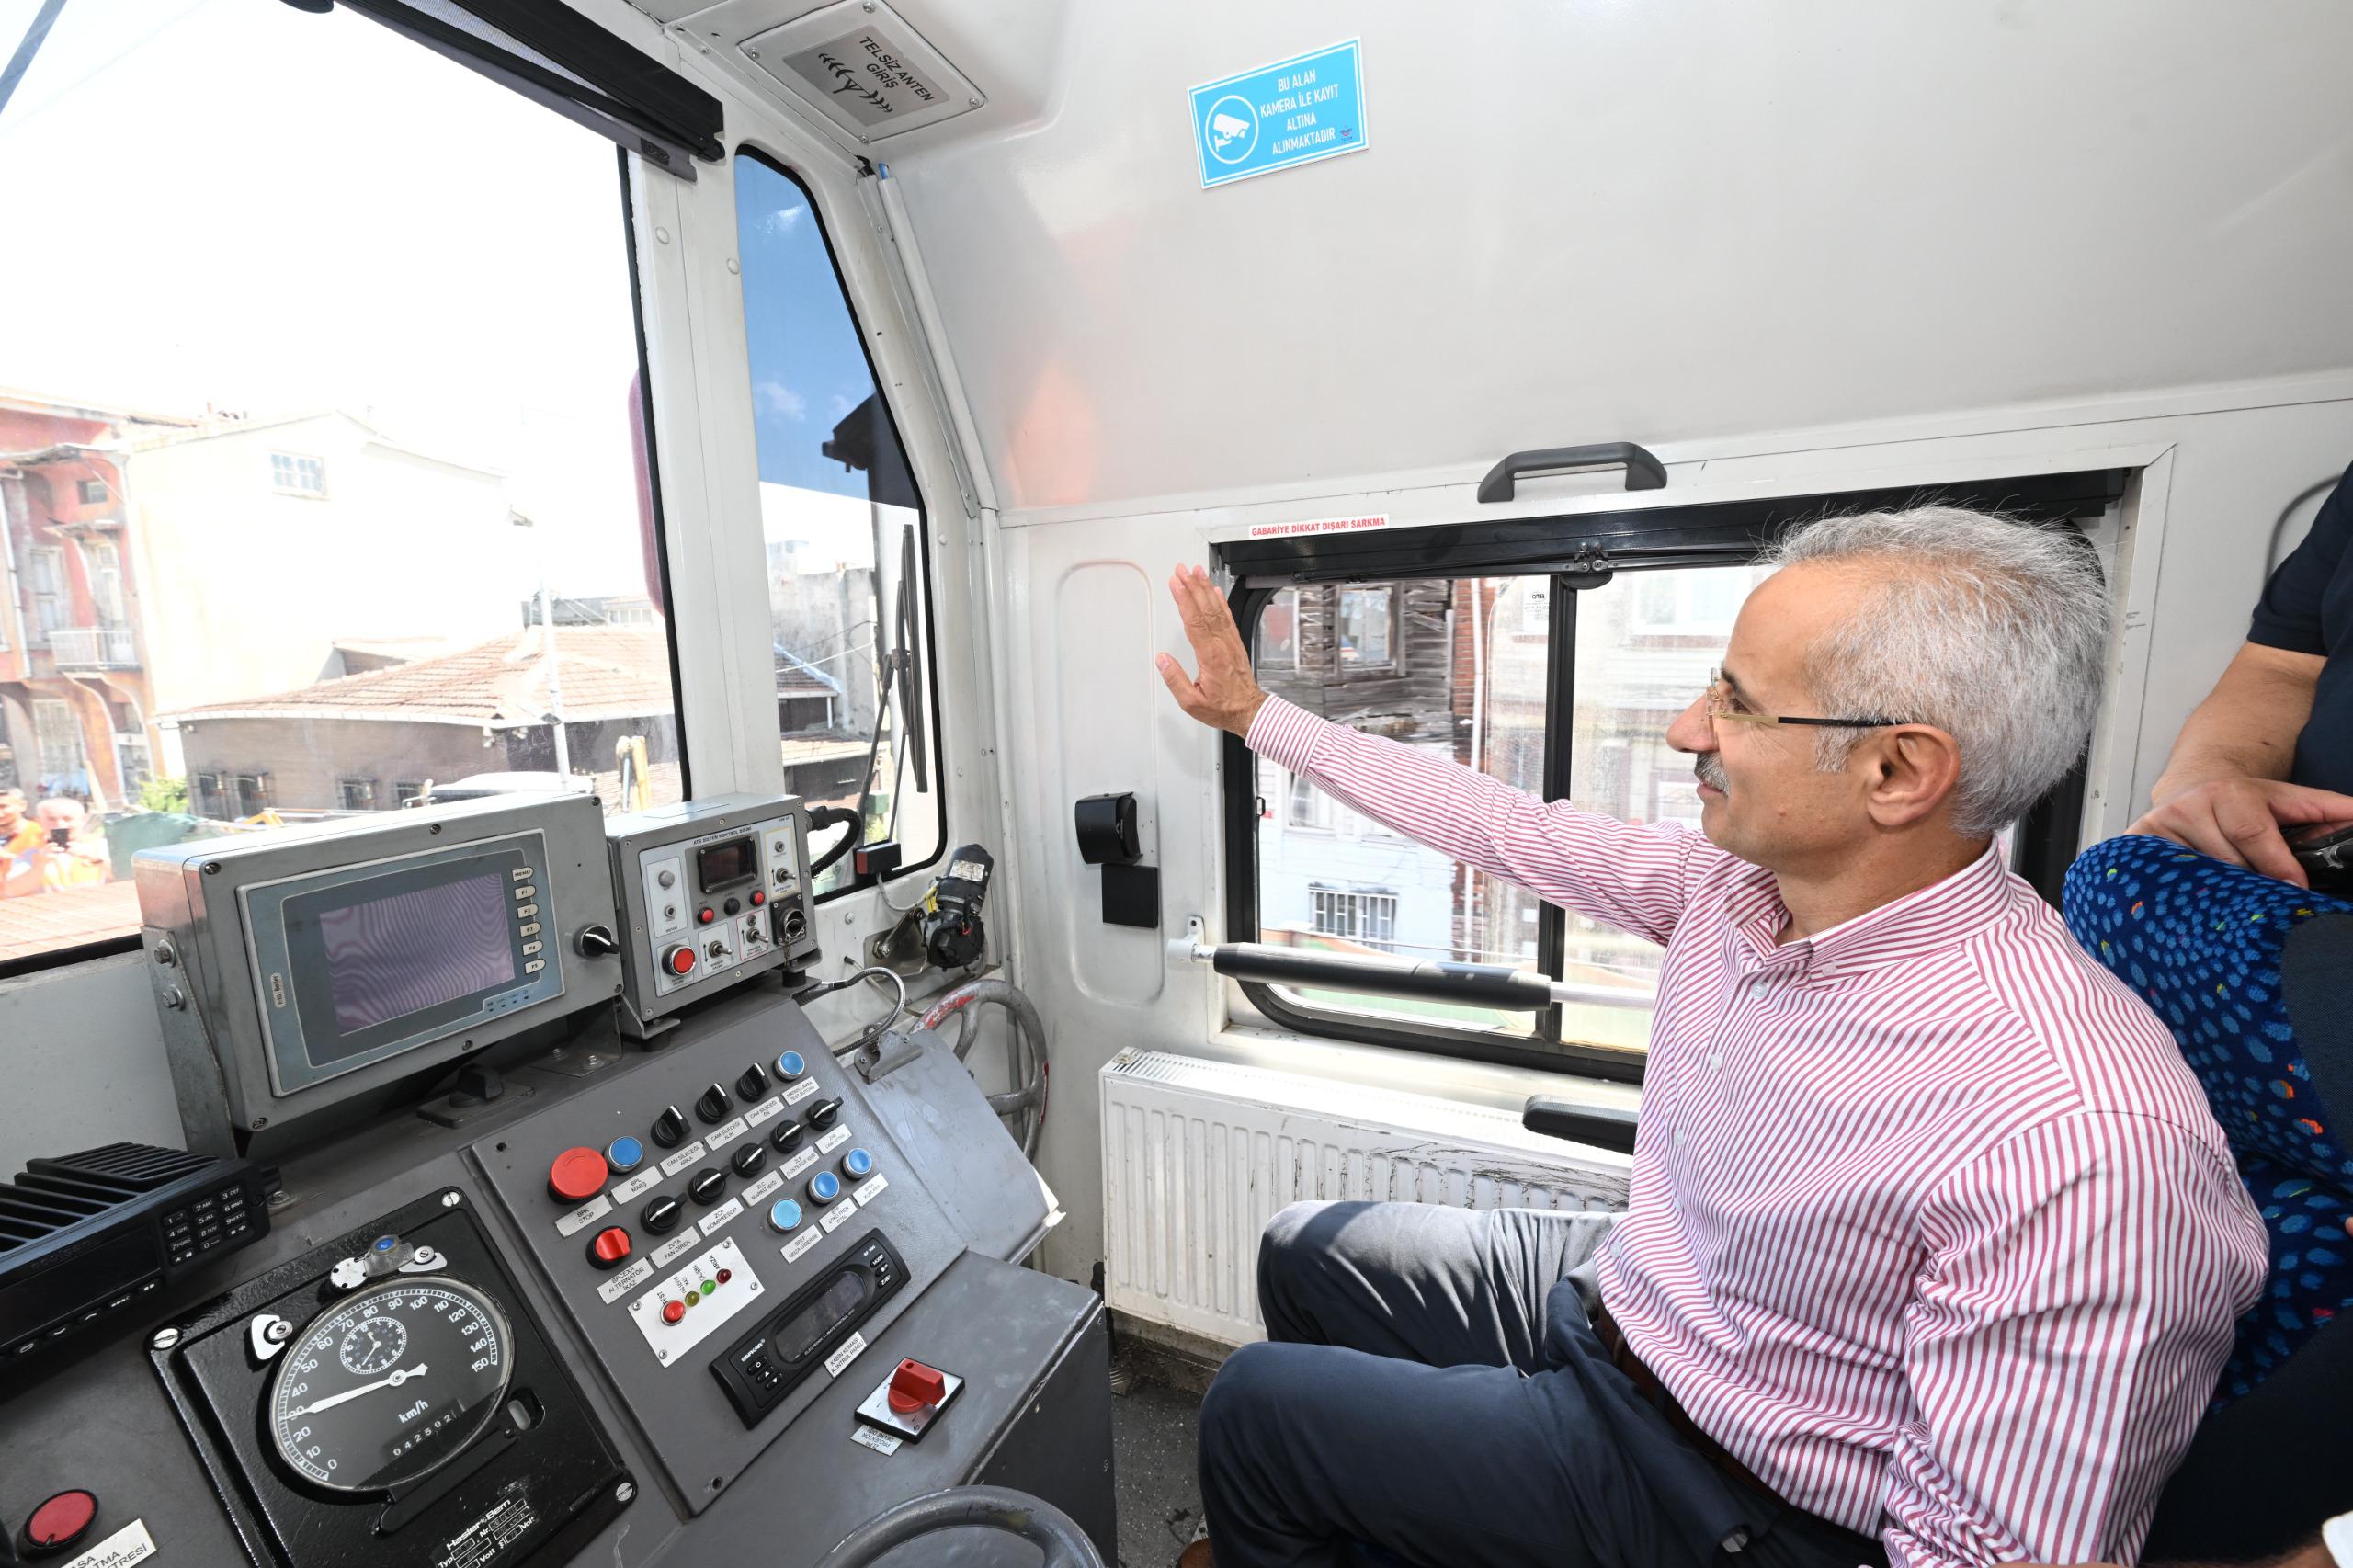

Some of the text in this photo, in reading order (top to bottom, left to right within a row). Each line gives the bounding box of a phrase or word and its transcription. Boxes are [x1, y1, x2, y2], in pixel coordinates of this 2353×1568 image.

[859, 36, 935, 101] TELSİZ ANTEN
[866, 63, 899, 89] GİRİŞ
[1278, 69, 1316, 93] BU ALAN
[1260, 84, 1339, 119] KAMERA İLE KAYIT
[1287, 112, 1317, 131] ALTINA
[1272, 127, 1336, 155] ALINMAKTADIR
[1252, 524, 1290, 536] GABARİYE
[1291, 522, 1320, 533] DİKKAT
[1350, 517, 1386, 528] SARKMA
[710, 1131, 722, 1142] CAM
[666, 1157, 679, 1167] CAM
[680, 1156, 693, 1166] ARKA
[631, 1177, 642, 1187] BPL
[631, 1181, 647, 1192] MARŞ
[576, 1208, 590, 1218] BPA
[578, 1211, 594, 1224] STOP
[714, 1209, 724, 1219] ZCP
[664, 1248, 677, 1260] FAN
[709, 1255, 721, 1270] ARIZA
[611, 1267, 635, 1283] BPCEXA
[387, 1297, 404, 1311] 90
[409, 1296, 429, 1311] 100
[657, 1290, 668, 1305] TEST
[362, 1305, 379, 1318] 80
[434, 1300, 449, 1312] 110
[448, 1309, 467, 1323] 120
[337, 1318, 355, 1333] 70
[461, 1322, 480, 1336] 130
[315, 1336, 334, 1351] 60
[470, 1337, 488, 1353] 140
[301, 1358, 319, 1373] 50
[471, 1357, 489, 1373] 150
[830, 1352, 844, 1365] KABİN
[831, 1354, 851, 1373] KONTROL
[292, 1382, 308, 1397] 40
[398, 1399, 429, 1424] km/h
[293, 1426, 311, 1443] 20
[306, 1445, 321, 1459] 10
[327, 1459, 337, 1470] 0
[446, 1521, 480, 1551] Hasler
[486, 1499, 511, 1520] Bern
[479, 1528, 491, 1538] Nr.
[92, 1551, 120, 1568] TMA
[438, 1557, 453, 1568] Typ
[479, 1548, 496, 1562] Volt
